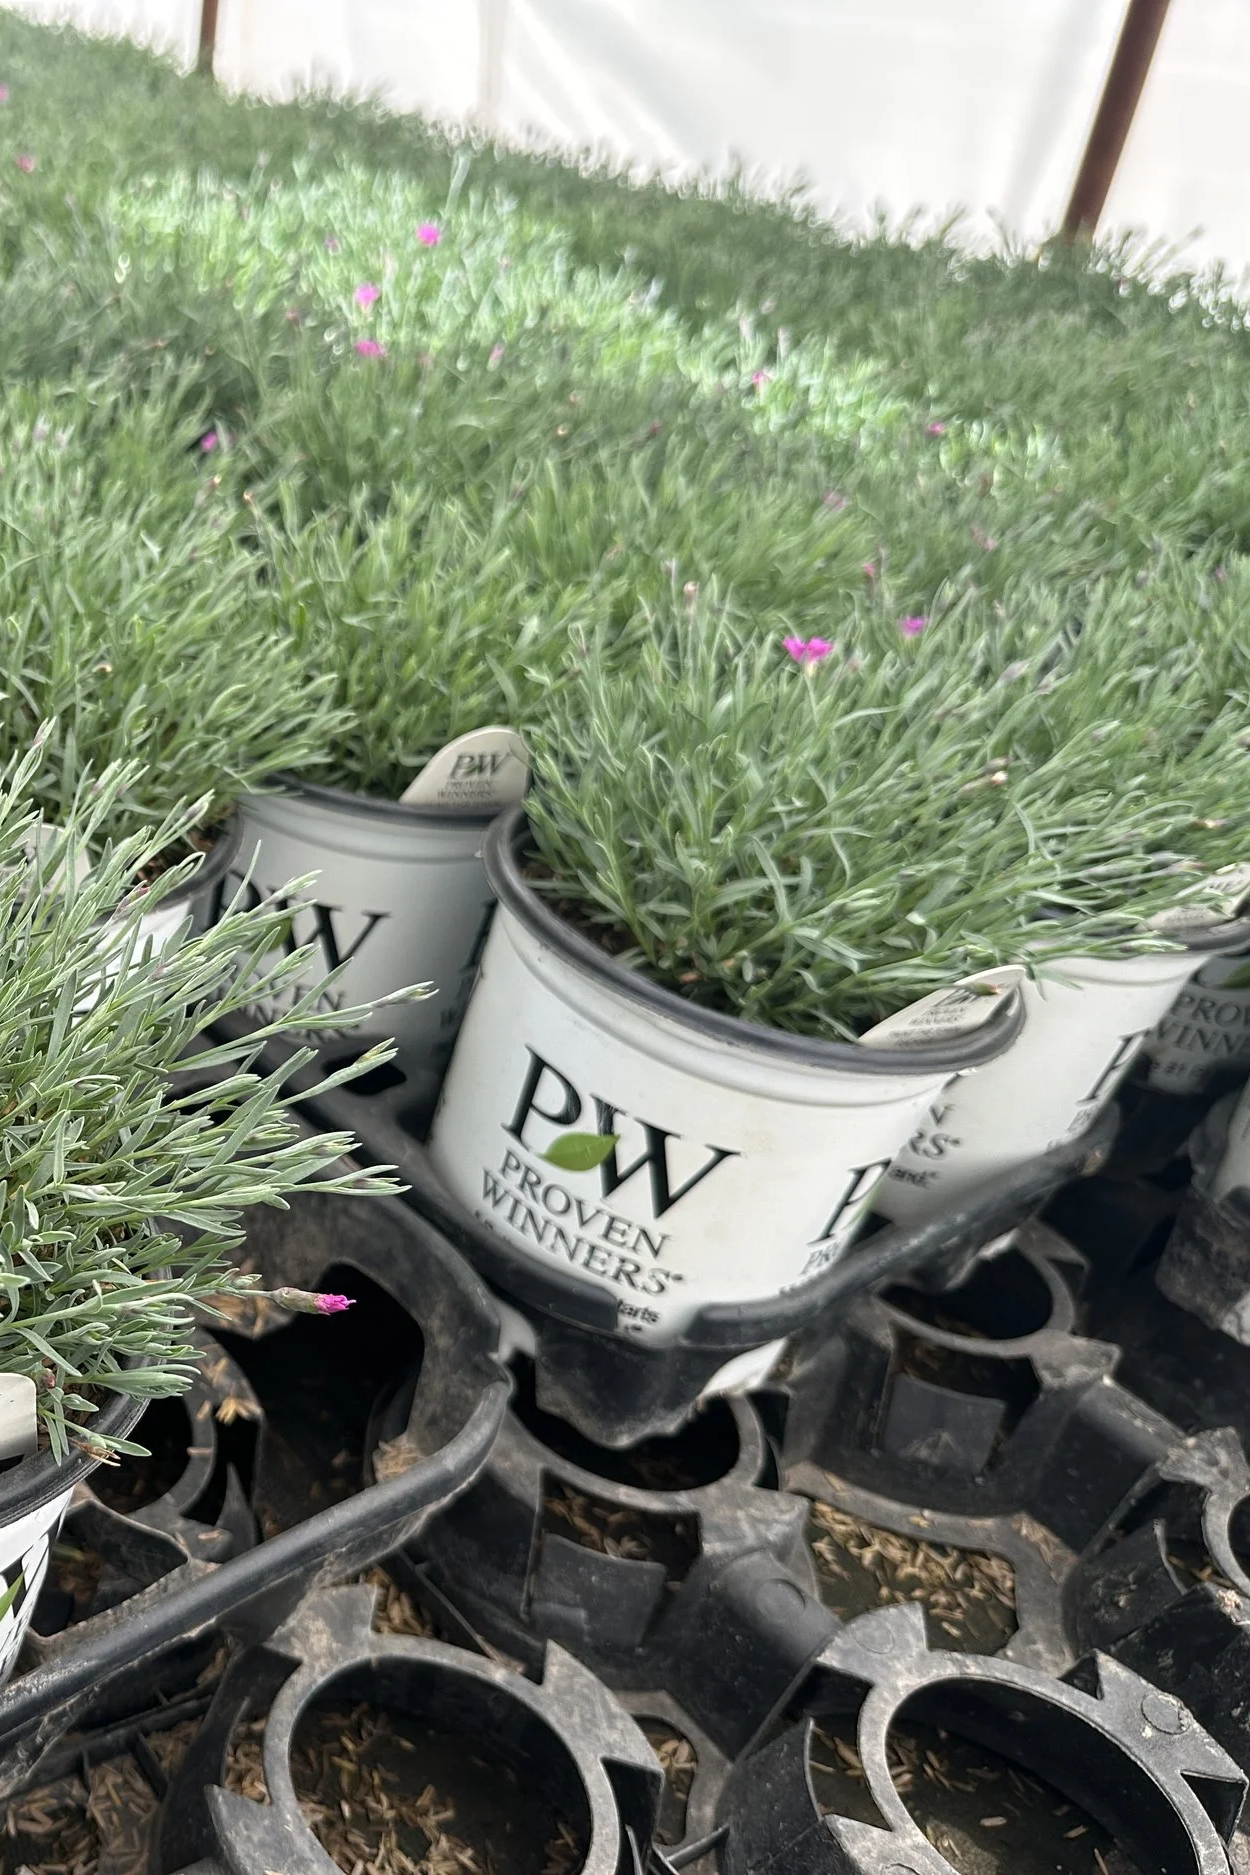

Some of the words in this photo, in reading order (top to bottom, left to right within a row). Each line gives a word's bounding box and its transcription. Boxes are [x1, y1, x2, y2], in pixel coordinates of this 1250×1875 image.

[501, 1043, 743, 1219] PW
[501, 1147, 673, 1260] PROVEN
[806, 1157, 892, 1247] P
